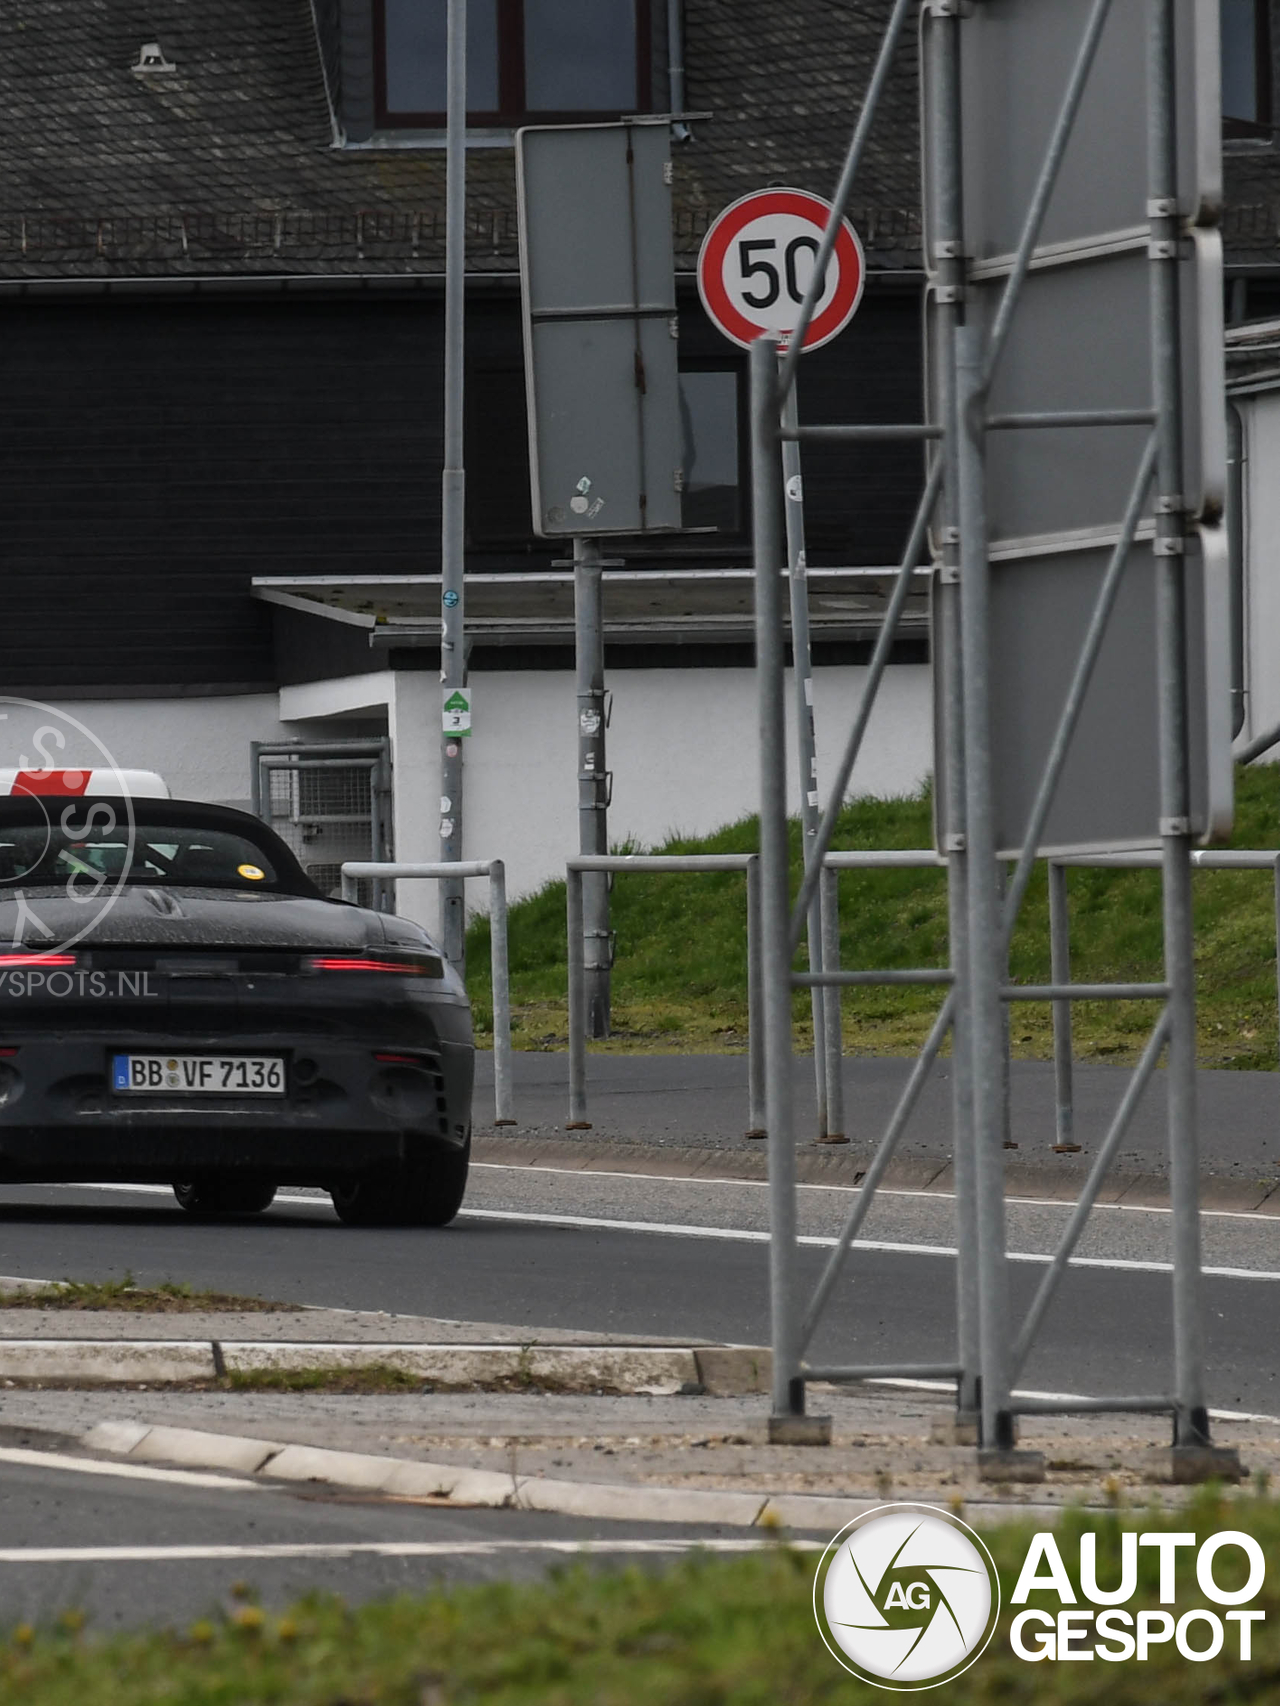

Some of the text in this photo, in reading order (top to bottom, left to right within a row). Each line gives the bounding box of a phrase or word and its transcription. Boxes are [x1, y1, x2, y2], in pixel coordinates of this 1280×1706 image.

[738, 236, 826, 309] 50
[131, 1060, 163, 1087] BB
[183, 1061, 214, 1087] VF
[220, 1062, 281, 1088] 7136
